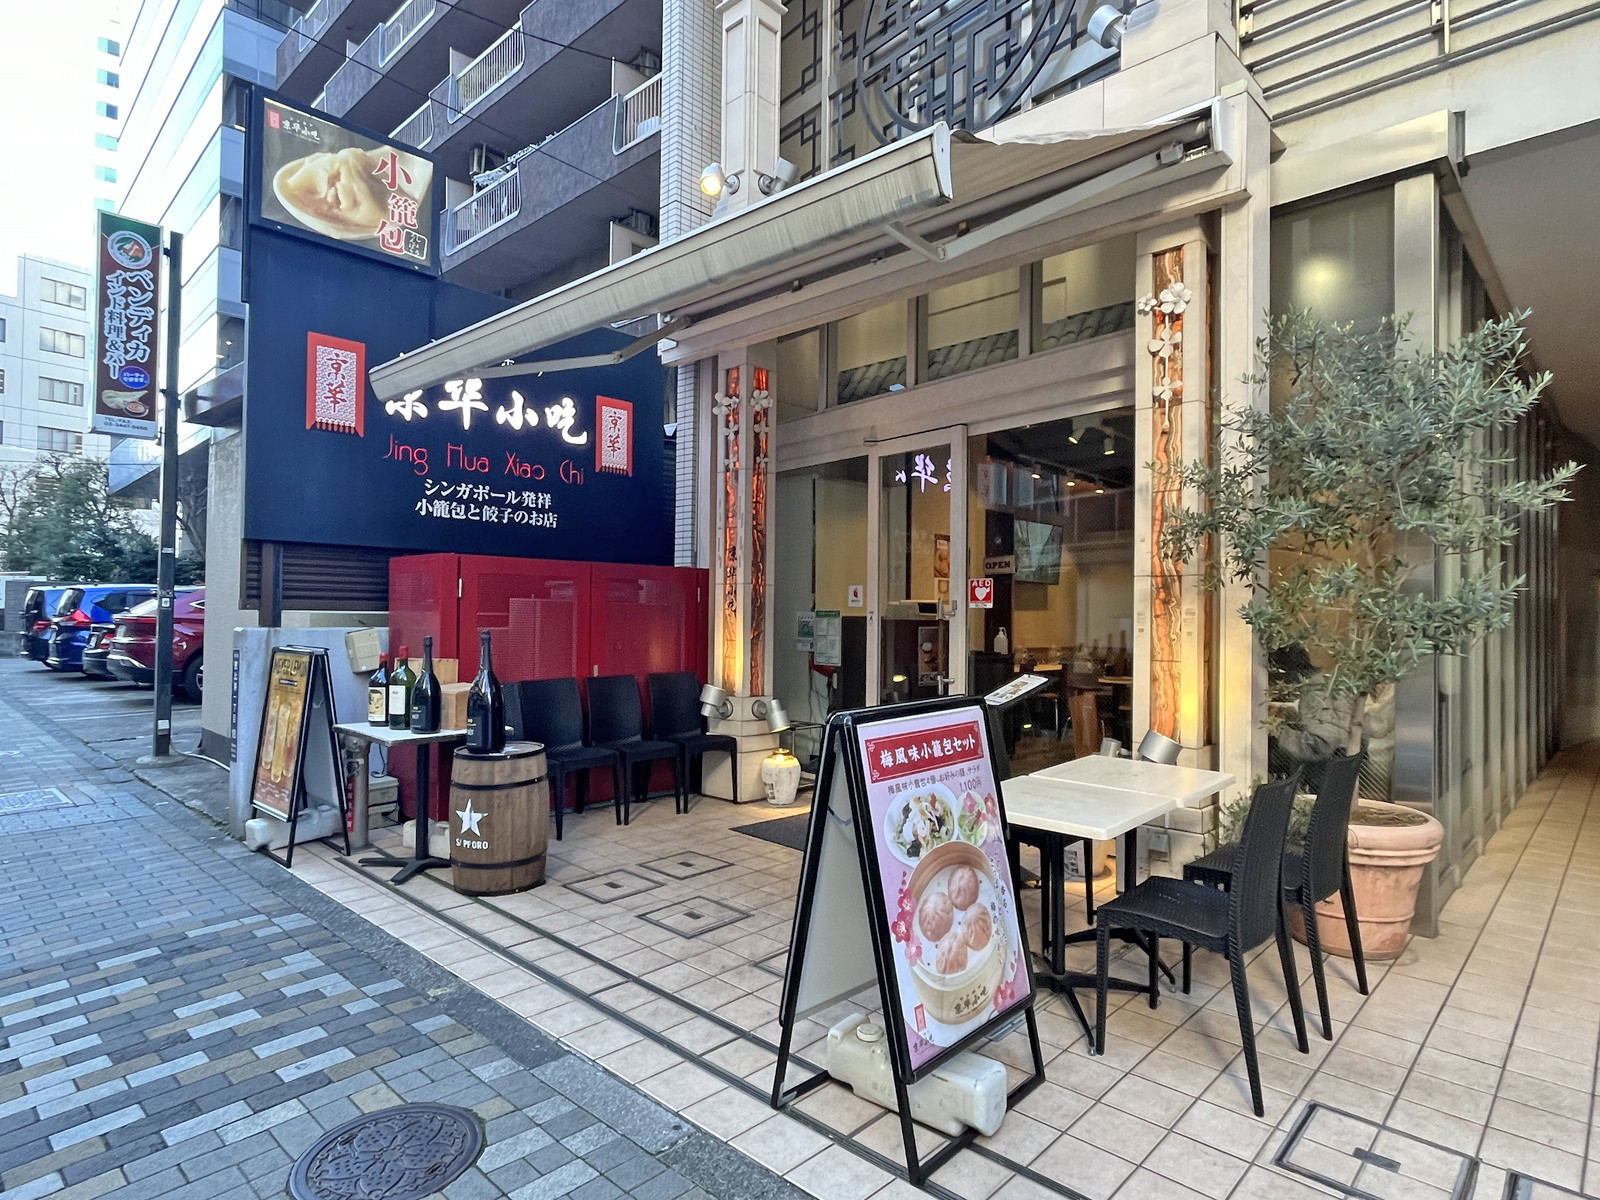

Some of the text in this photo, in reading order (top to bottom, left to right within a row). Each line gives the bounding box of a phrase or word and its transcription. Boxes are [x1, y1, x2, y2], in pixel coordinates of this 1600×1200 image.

[372, 152, 418, 253] 小籠包
[125, 269, 155, 363] ベンディカ
[382, 433, 584, 485] Jing Hua Xiao Chi
[424, 478, 552, 509] シンガポール発祥
[415, 498, 558, 528] 小籠包と餃子のお店
[985, 561, 1010, 569] OPEN
[880, 733, 976, 768] 梅風味小籠包セット
